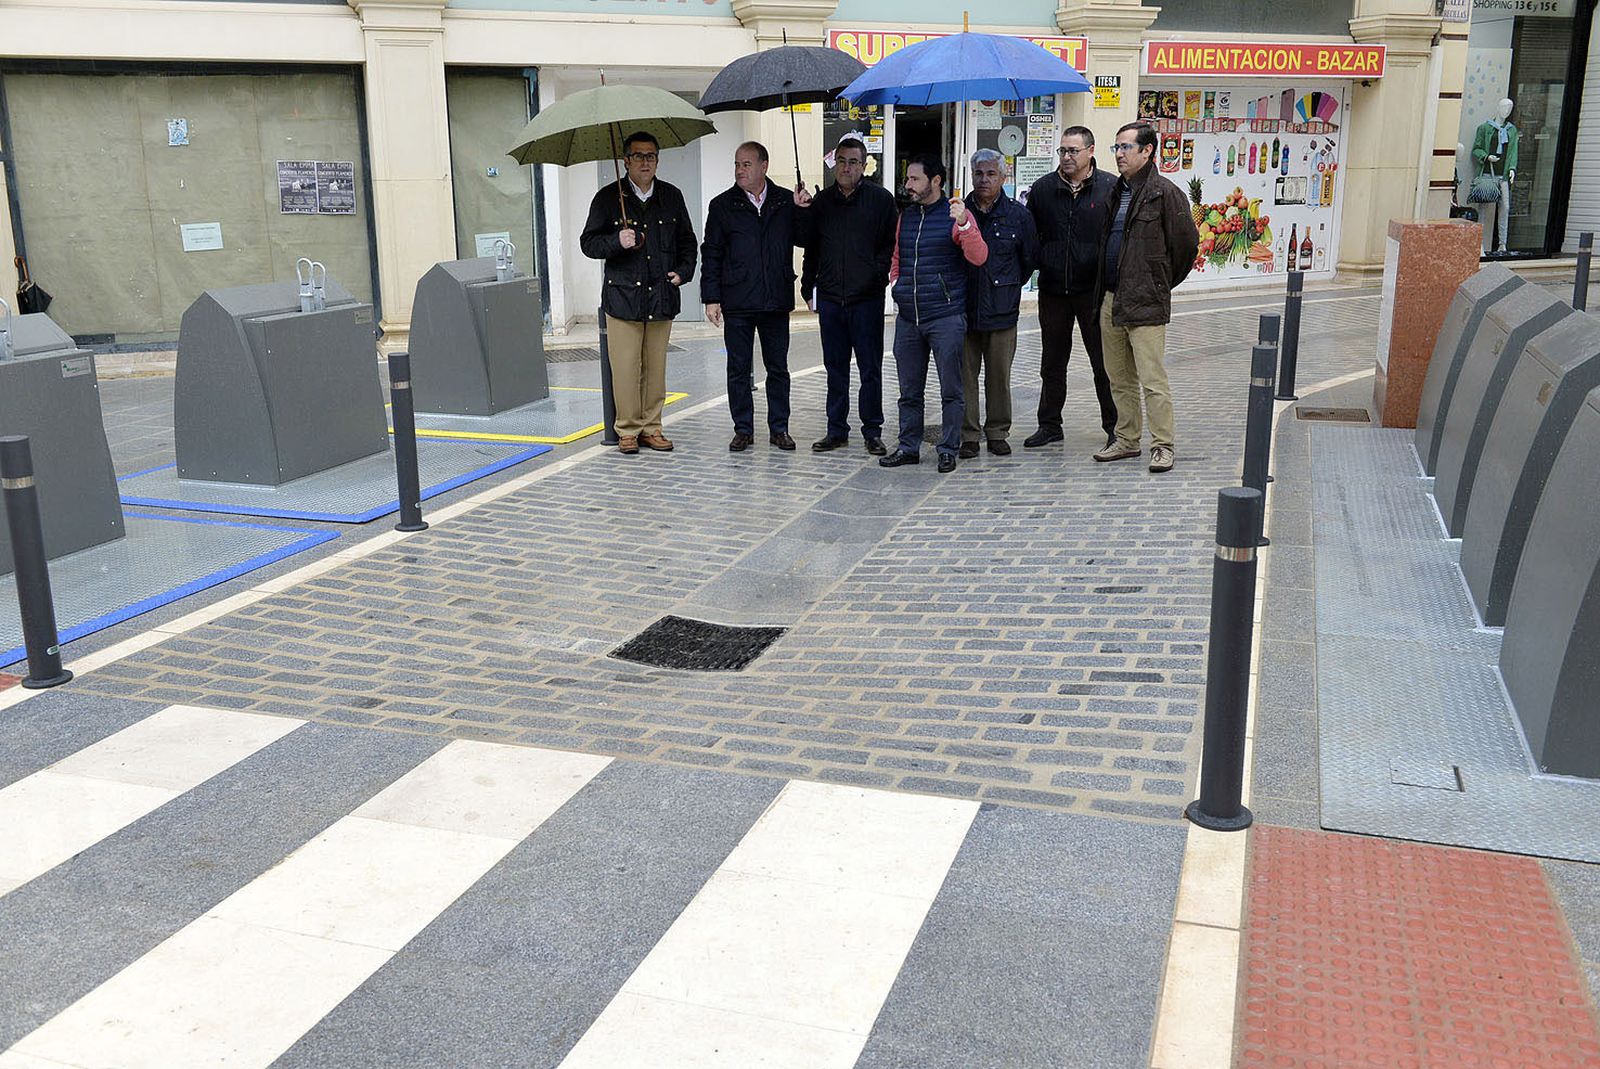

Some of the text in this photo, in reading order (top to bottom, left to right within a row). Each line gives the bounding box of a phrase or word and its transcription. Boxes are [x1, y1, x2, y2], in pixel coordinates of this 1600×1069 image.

[1473, 0, 1512, 9] SHOPPING
[1153, 48, 1301, 71] ALIMENTACION
[1317, 50, 1378, 72] BAZAR
[1098, 76, 1117, 87] ITESA
